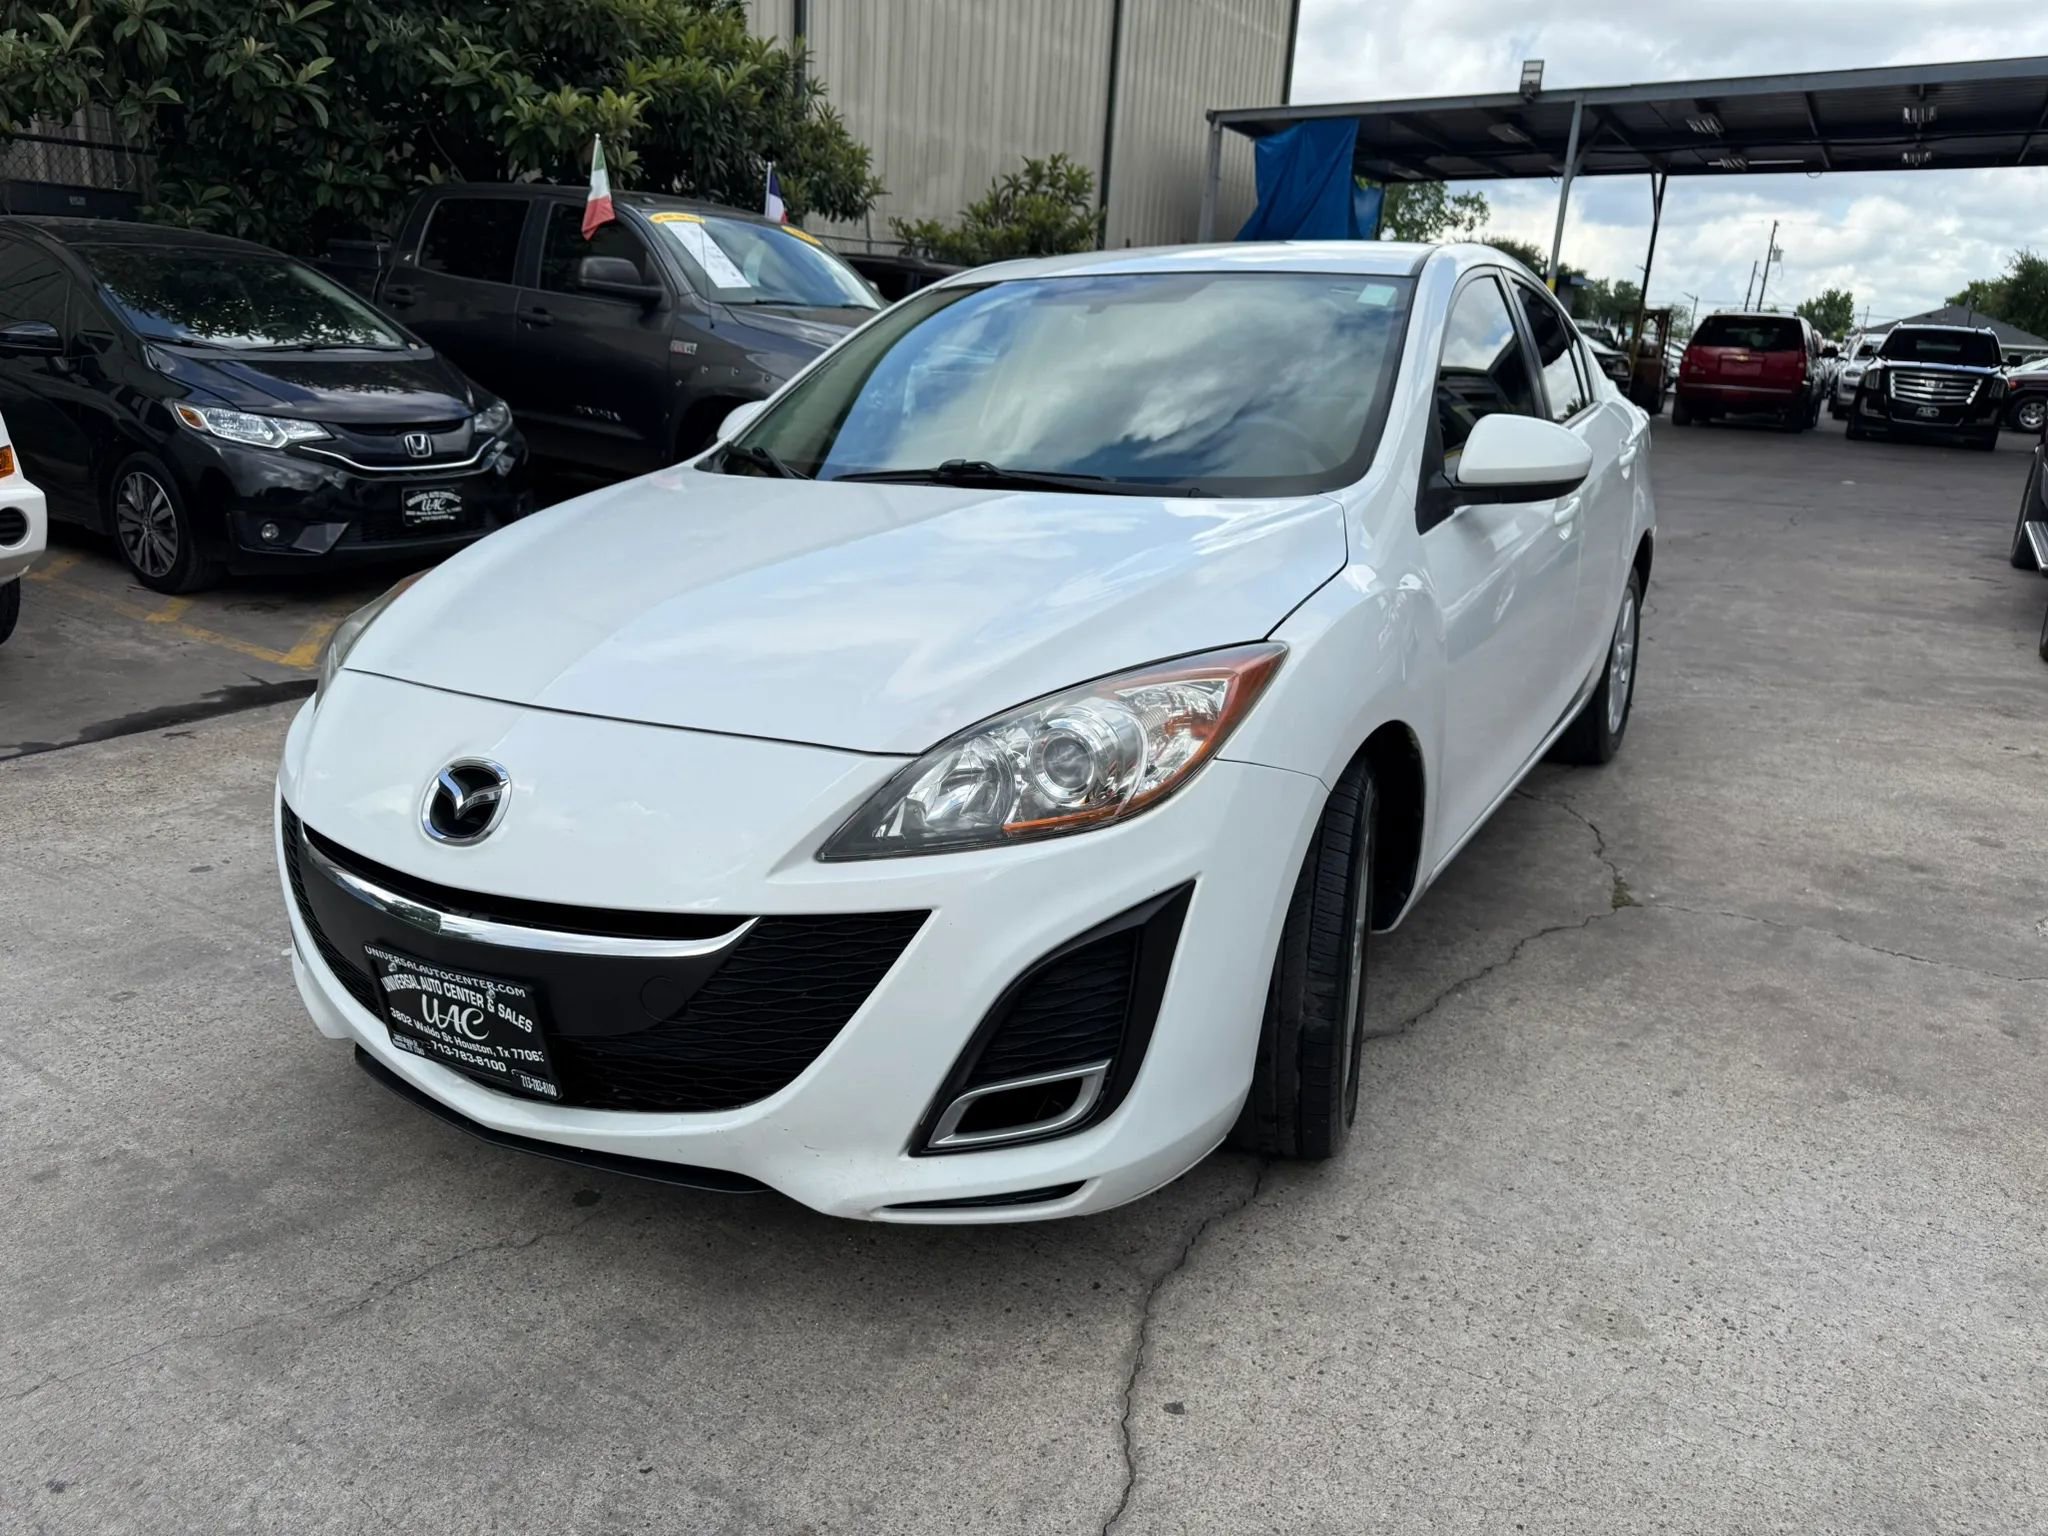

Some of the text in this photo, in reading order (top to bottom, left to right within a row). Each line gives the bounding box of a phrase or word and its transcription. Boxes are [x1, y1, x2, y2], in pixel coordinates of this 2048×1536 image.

[380, 974, 421, 992] UNIVERSAL
[419, 976, 443, 995] AUTO
[443, 982, 484, 1008] CENTER
[498, 1003, 533, 1033] SALES
[421, 994, 490, 1040] UAC
[390, 1007, 414, 1027] 3802
[413, 1019, 441, 1039] Waldo
[441, 1031, 454, 1044] St
[453, 1036, 497, 1057] Houston,
[496, 1046, 511, 1058] Tx
[431, 1040, 507, 1073] 713-783-8100
